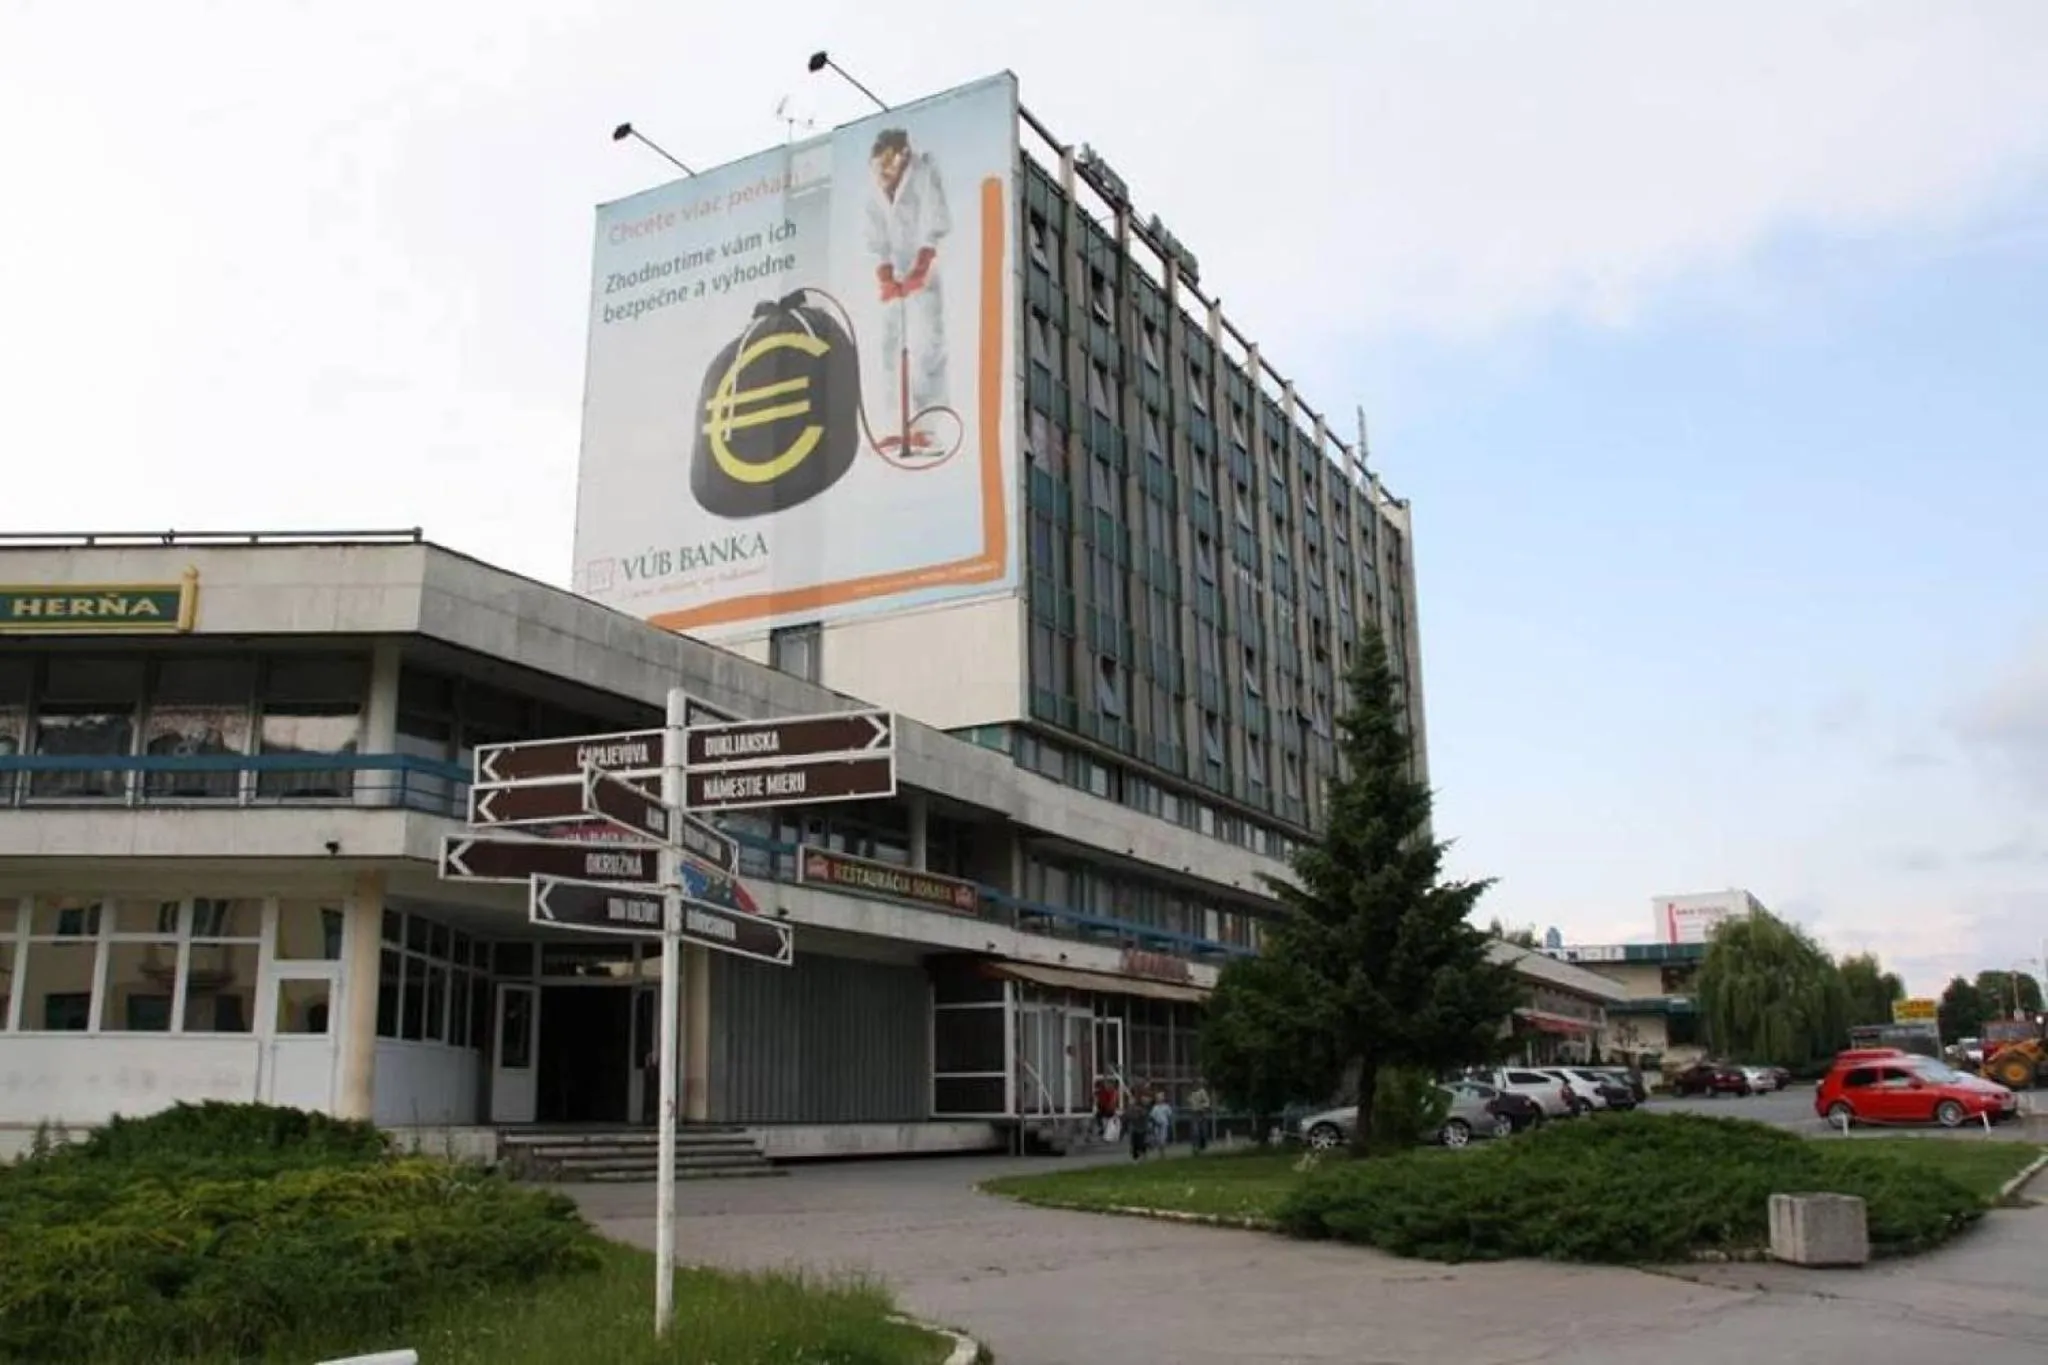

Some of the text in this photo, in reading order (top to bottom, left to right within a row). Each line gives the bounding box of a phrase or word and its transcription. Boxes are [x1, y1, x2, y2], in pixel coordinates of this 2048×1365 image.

[608, 211, 676, 245] Chcete
[682, 194, 724, 220] viac
[721, 231, 764, 258] vám
[769, 217, 797, 244] ich
[694, 279, 706, 298] a
[622, 531, 769, 581] VÚB BANKA
[12, 592, 161, 616] HERŇA
[703, 771, 806, 800] NÁMESTIE MIERU
